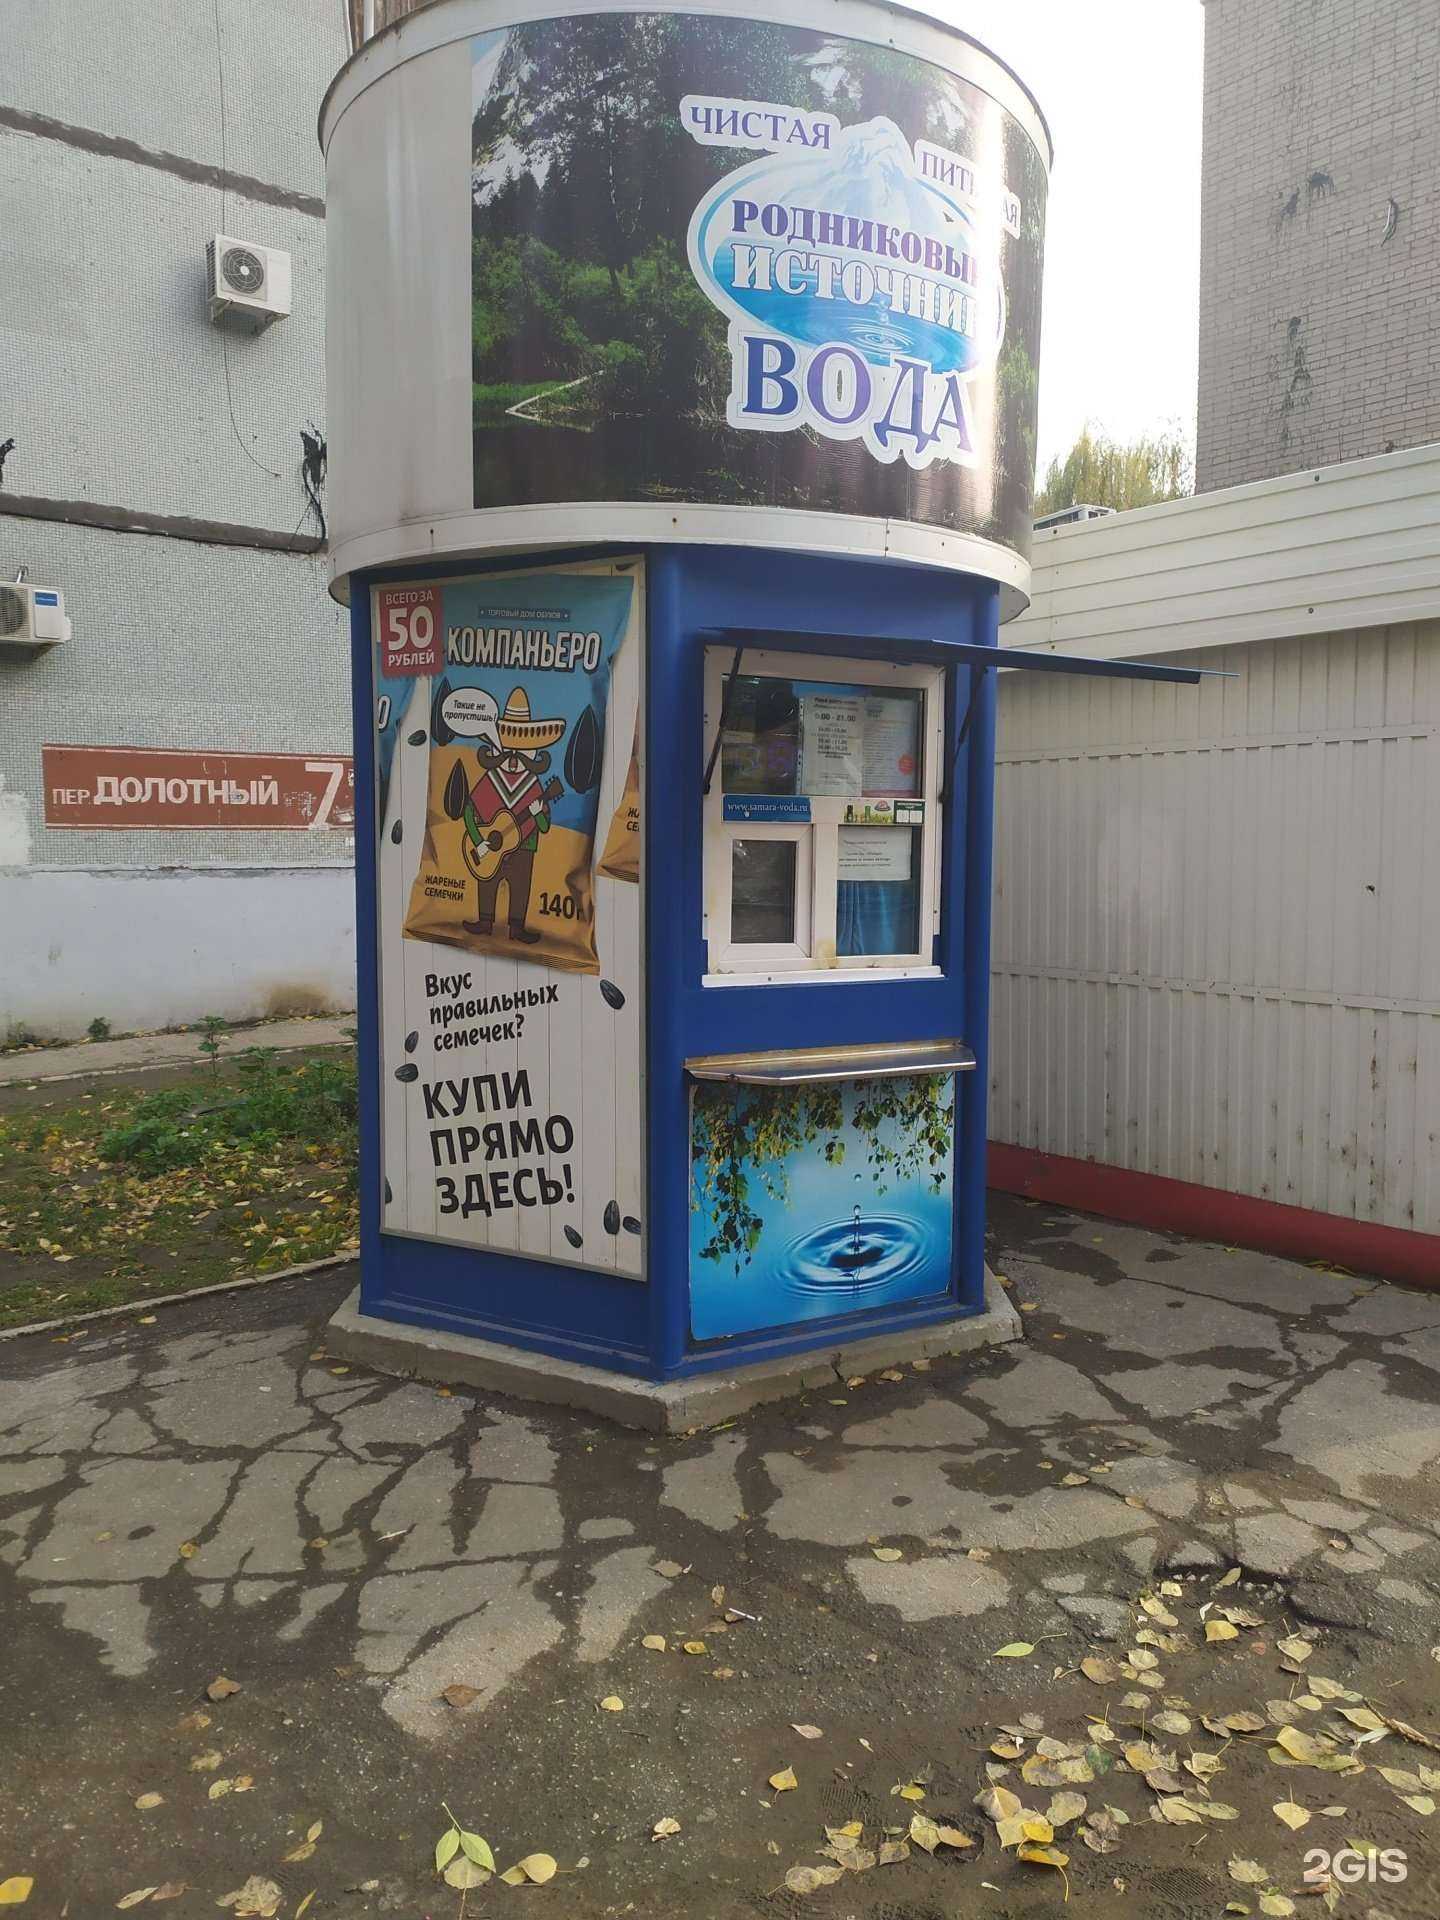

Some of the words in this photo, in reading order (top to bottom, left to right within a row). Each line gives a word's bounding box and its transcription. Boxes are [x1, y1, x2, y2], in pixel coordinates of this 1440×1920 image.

[691, 106, 831, 150] ЧИСТАЯ
[922, 151, 1018, 228] ПИТЯ
[732, 199, 978, 288] РОДНИКОВЫ
[742, 336, 974, 454] ВОДА
[385, 591, 418, 605] ВСЕГО
[419, 590, 434, 602] ЗА
[387, 606, 435, 650] 50
[447, 626, 602, 671] КОМПАНЬЕРО
[387, 650, 436, 667] РУБЛЕЙ
[444, 711, 498, 722] пропустишь!
[453, 699, 475, 710] Такие
[94, 775, 279, 805] ДОЛОТНЫЙ
[727, 802, 808, 812] www.samara-voda.ru
[424, 874, 466, 891] ЖАРЕНЫЕ
[424, 886, 464, 902] СЕМЕЧКИ
[424, 971, 473, 998] Вкус
[429, 983, 559, 1028] правильных
[433, 1012, 525, 1052] семечек?
[422, 1069, 533, 1120] КУПИ
[429, 1114, 574, 1167] ПРЯМО
[435, 1163, 576, 1219] ЗДЕСЬ!
